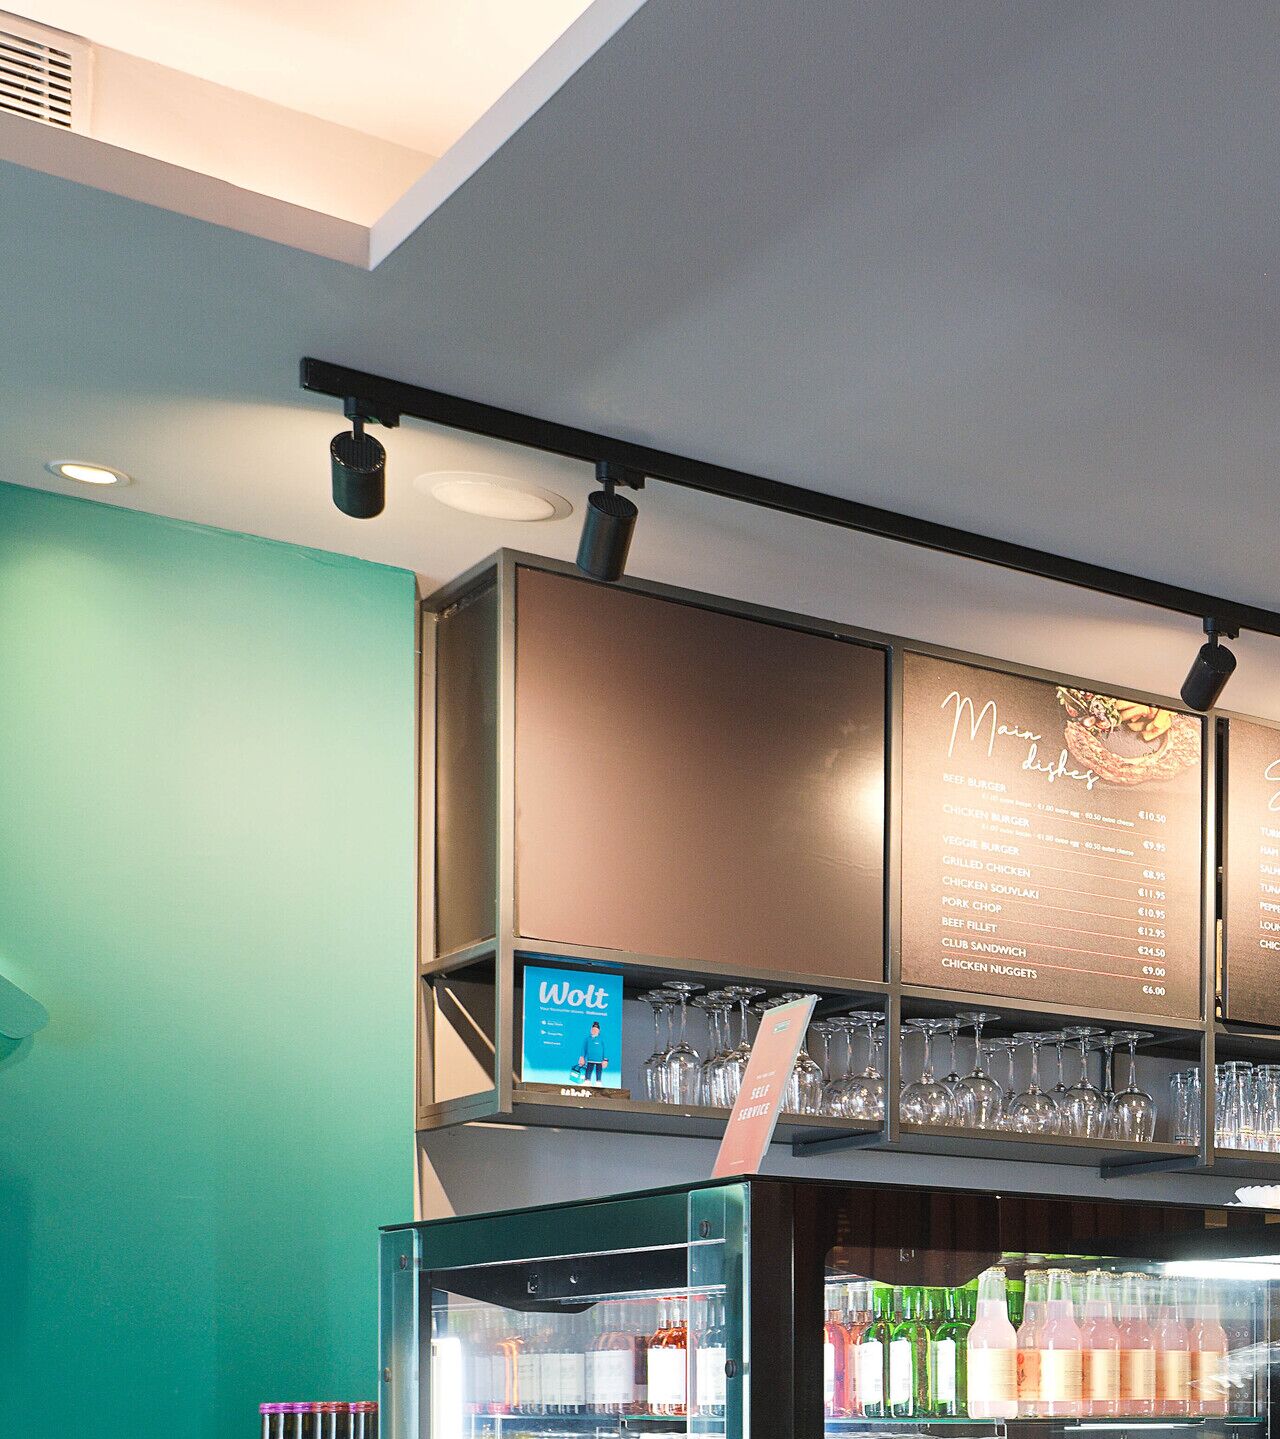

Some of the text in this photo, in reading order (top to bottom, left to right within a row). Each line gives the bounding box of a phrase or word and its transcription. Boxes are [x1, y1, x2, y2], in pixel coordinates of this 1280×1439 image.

[941, 691, 1041, 757] Main
[1022, 743, 1100, 790] dishes
[943, 774, 1166, 825] BEEF BURGER €10.50
[943, 804, 988, 819] CHICKEN
[991, 812, 1029, 827] BURGER
[943, 835, 977, 849] VEGGIE
[981, 841, 1019, 856] BURGER
[942, 855, 1166, 900] GRILLED CHICKEN €11.95
[942, 875, 1166, 920] CHICKEN SOUVLAKI €10.95
[941, 916, 1166, 959] BEEF FILLET €24.50
[942, 896, 1166, 939] PORK CHOP €12.95
[941, 937, 1166, 977] CLUB SANDWICH €9.00
[941, 957, 1166, 996] CHICKEN NUGGETS €6.00
[539, 981, 608, 1009] Wolt
[737, 1102, 771, 1121] SERVICE
[750, 1084, 770, 1100] SELF
